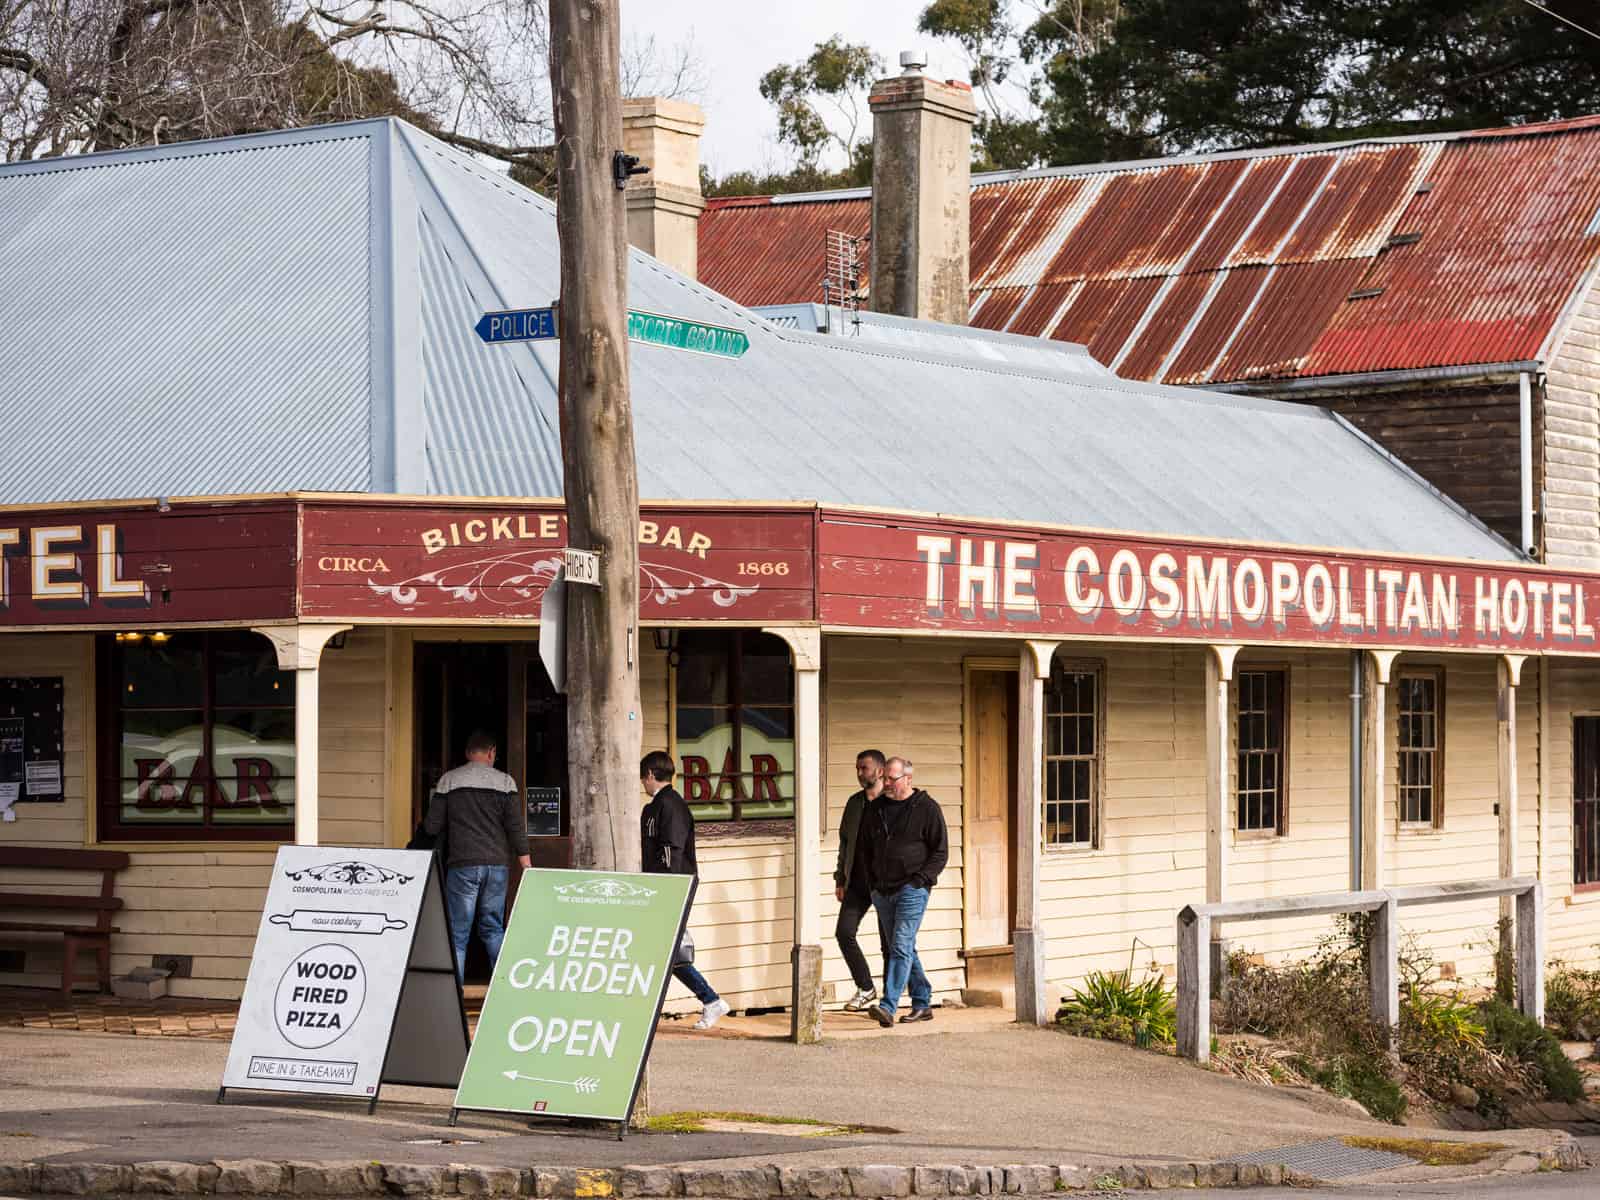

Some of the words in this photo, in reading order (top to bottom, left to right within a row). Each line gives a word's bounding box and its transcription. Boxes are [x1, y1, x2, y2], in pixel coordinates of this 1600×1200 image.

[490, 313, 549, 340] POLICE
[686, 326, 745, 357] GROUND
[421, 515, 567, 554] BICKLE
[638, 520, 712, 560] BAR
[318, 556, 390, 572] CIRCA
[566, 552, 584, 577] HIGH
[587, 556, 594, 579] S
[737, 562, 790, 575] 1866
[917, 535, 1038, 614] THE
[1064, 546, 1458, 633] COSMOPOLITAN
[1475, 576, 1595, 639] HOTEL
[134, 755, 282, 809] BAR
[681, 746, 781, 801] BAR
[292, 886, 342, 894] COSMOPOLITAN
[312, 917, 329, 925] now
[330, 916, 362, 929] cooking
[546, 925, 633, 960] BEER
[297, 961, 357, 981] WOOD
[508, 957, 655, 997] GARDEN
[292, 986, 348, 1004] FIRED
[286, 1010, 341, 1029] PIZZA
[507, 1015, 622, 1058] OPEN
[252, 1061, 276, 1074] DINE
[277, 1064, 288, 1074] IN
[289, 1064, 297, 1076] &
[300, 1065, 354, 1078] TAKEAWAY
